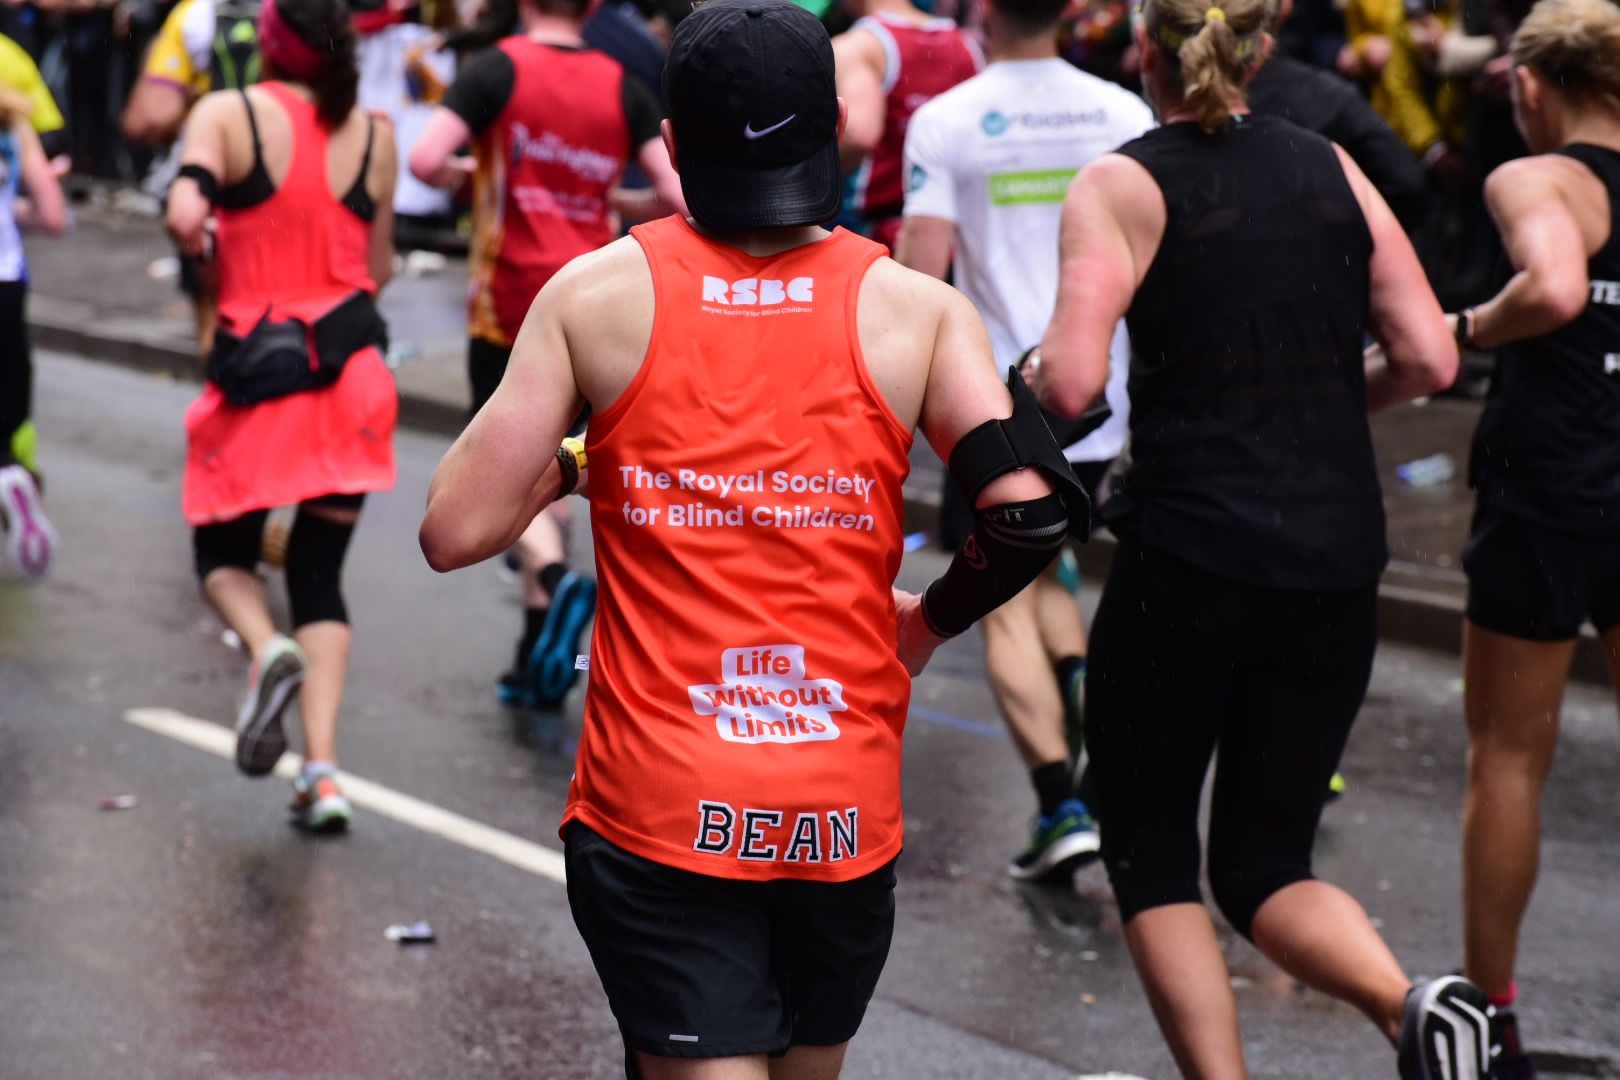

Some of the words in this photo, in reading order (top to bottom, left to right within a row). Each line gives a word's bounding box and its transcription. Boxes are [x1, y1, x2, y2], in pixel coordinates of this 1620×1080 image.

[702, 275, 814, 305] RSBC
[618, 465, 671, 489] The
[678, 469, 764, 499] Royal
[772, 470, 876, 503] Society
[622, 501, 661, 526] for
[668, 502, 744, 527] Blind
[751, 506, 874, 531] Children
[736, 650, 792, 676] Life
[703, 684, 833, 708] without
[729, 710, 828, 738] Limits
[693, 800, 859, 864] BEAN
